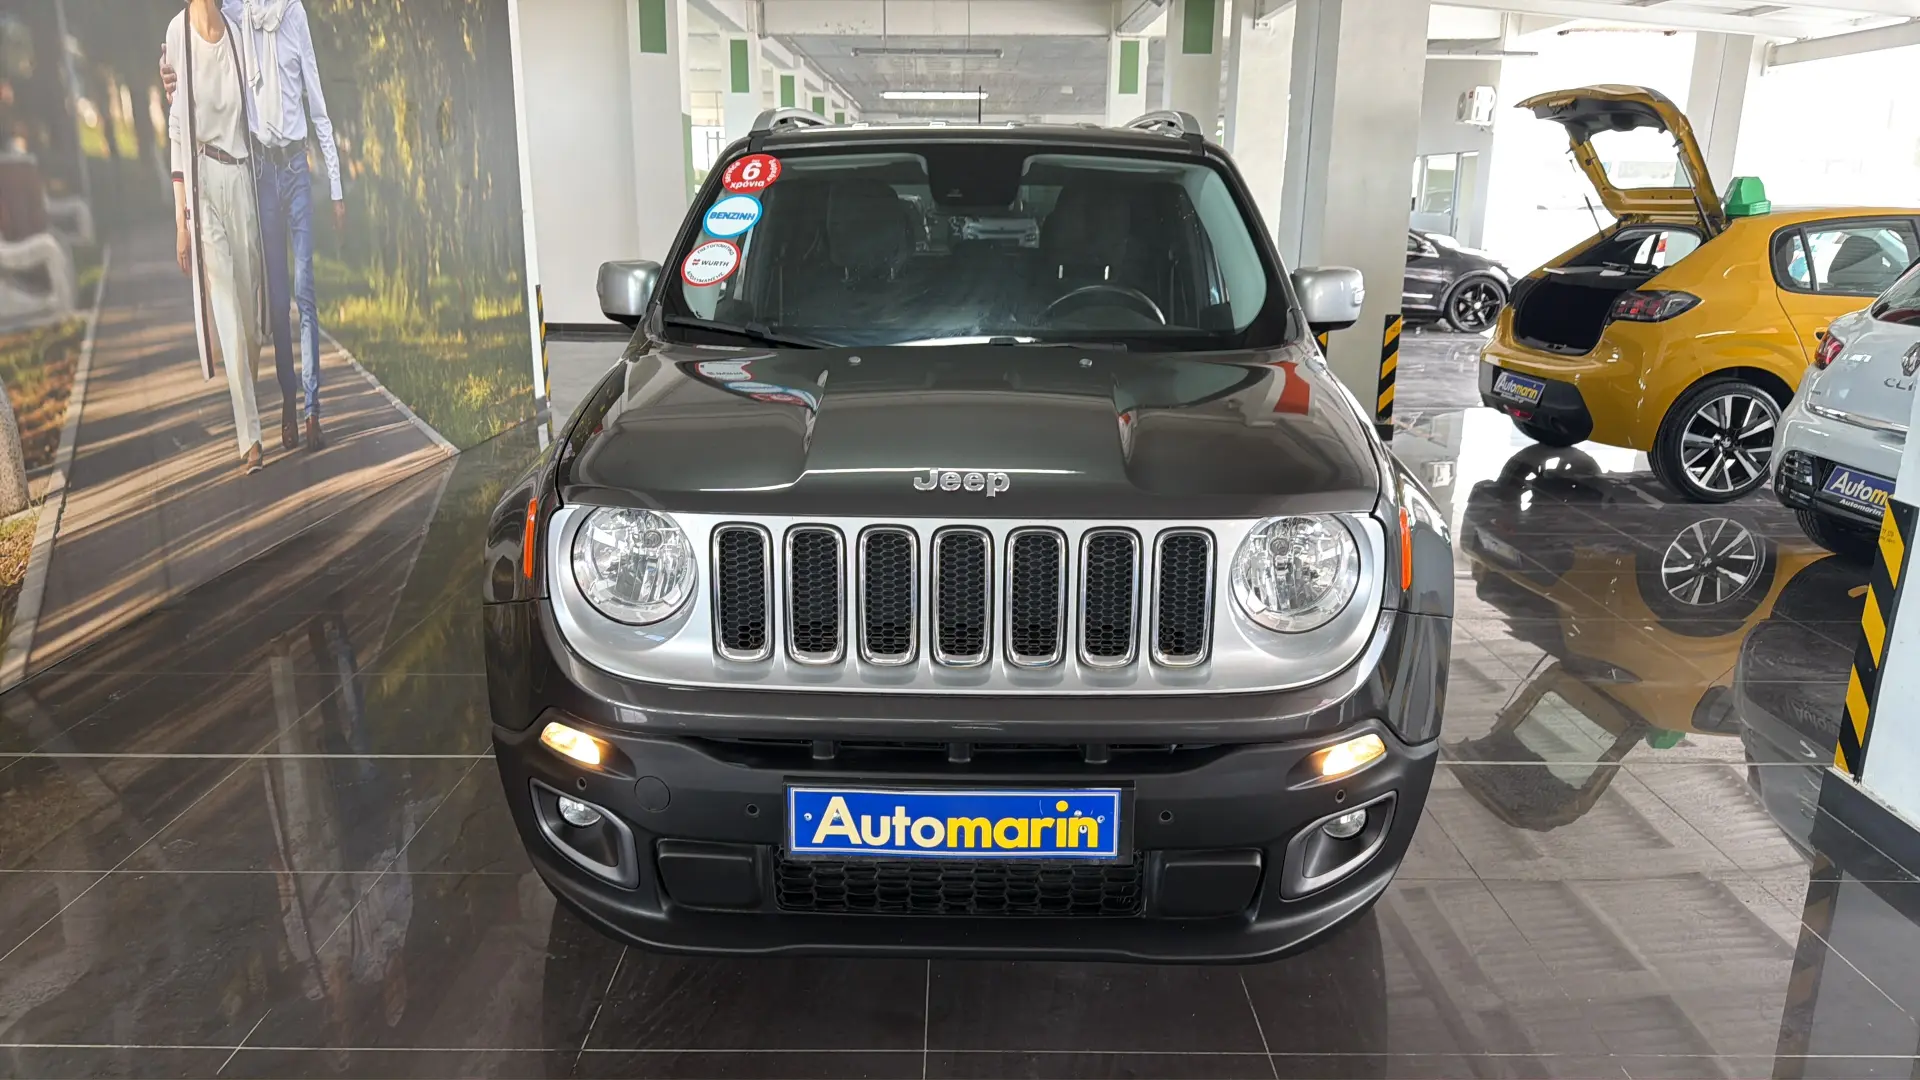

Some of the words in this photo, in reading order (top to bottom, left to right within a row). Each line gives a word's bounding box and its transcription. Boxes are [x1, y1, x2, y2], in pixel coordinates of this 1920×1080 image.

[742, 162, 762, 180] 6
[730, 180, 765, 190] χρόνια
[1498, 375, 1538, 400] Automarin
[1883, 378, 1914, 391] CLI
[913, 467, 1010, 497] Jeep
[1830, 471, 1895, 506] Autom
[811, 796, 1098, 849] Automarin
